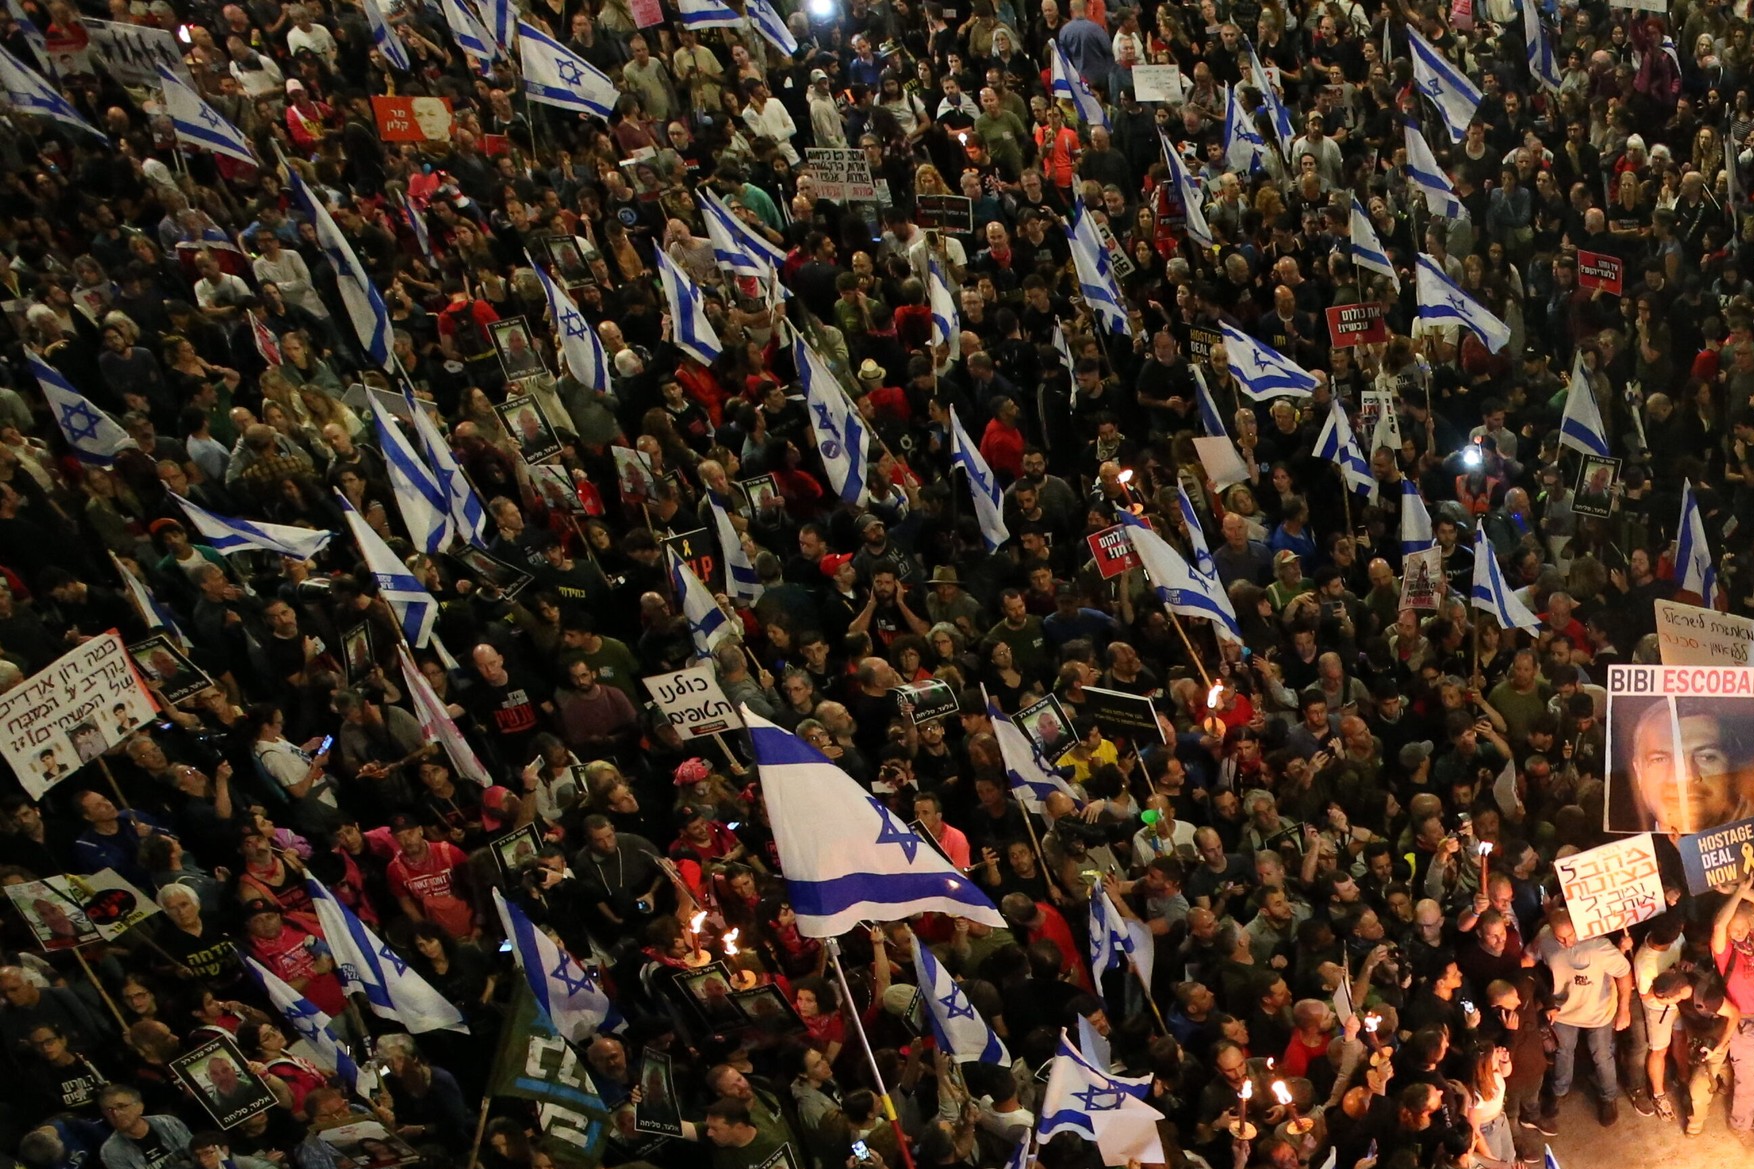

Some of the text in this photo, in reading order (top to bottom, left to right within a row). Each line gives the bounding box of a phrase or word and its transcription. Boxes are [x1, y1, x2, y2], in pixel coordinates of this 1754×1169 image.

[1341, 306, 1381, 321] את כולם
[1337, 321, 1369, 334] עכשיו!
[1191, 341, 1209, 356] DEAL
[1662, 606, 1705, 629] לישראל
[83, 638, 118, 667] כמה
[83, 656, 128, 694] נקריב
[108, 674, 137, 698] של
[1611, 668, 1655, 694] BIBI
[659, 673, 708, 704] כולנו
[668, 700, 734, 726] חטופים
[1697, 823, 1754, 853] HOSTAGE
[1700, 848, 1735, 871] DEAL
[1564, 862, 1658, 901] בציונות
[1705, 863, 1739, 888] NOW
[1579, 882, 1646, 913] ומוביל
[1594, 891, 1656, 918] אותנו
[1582, 900, 1656, 939] לגלות
[223, 1107, 249, 1123] סליחה
